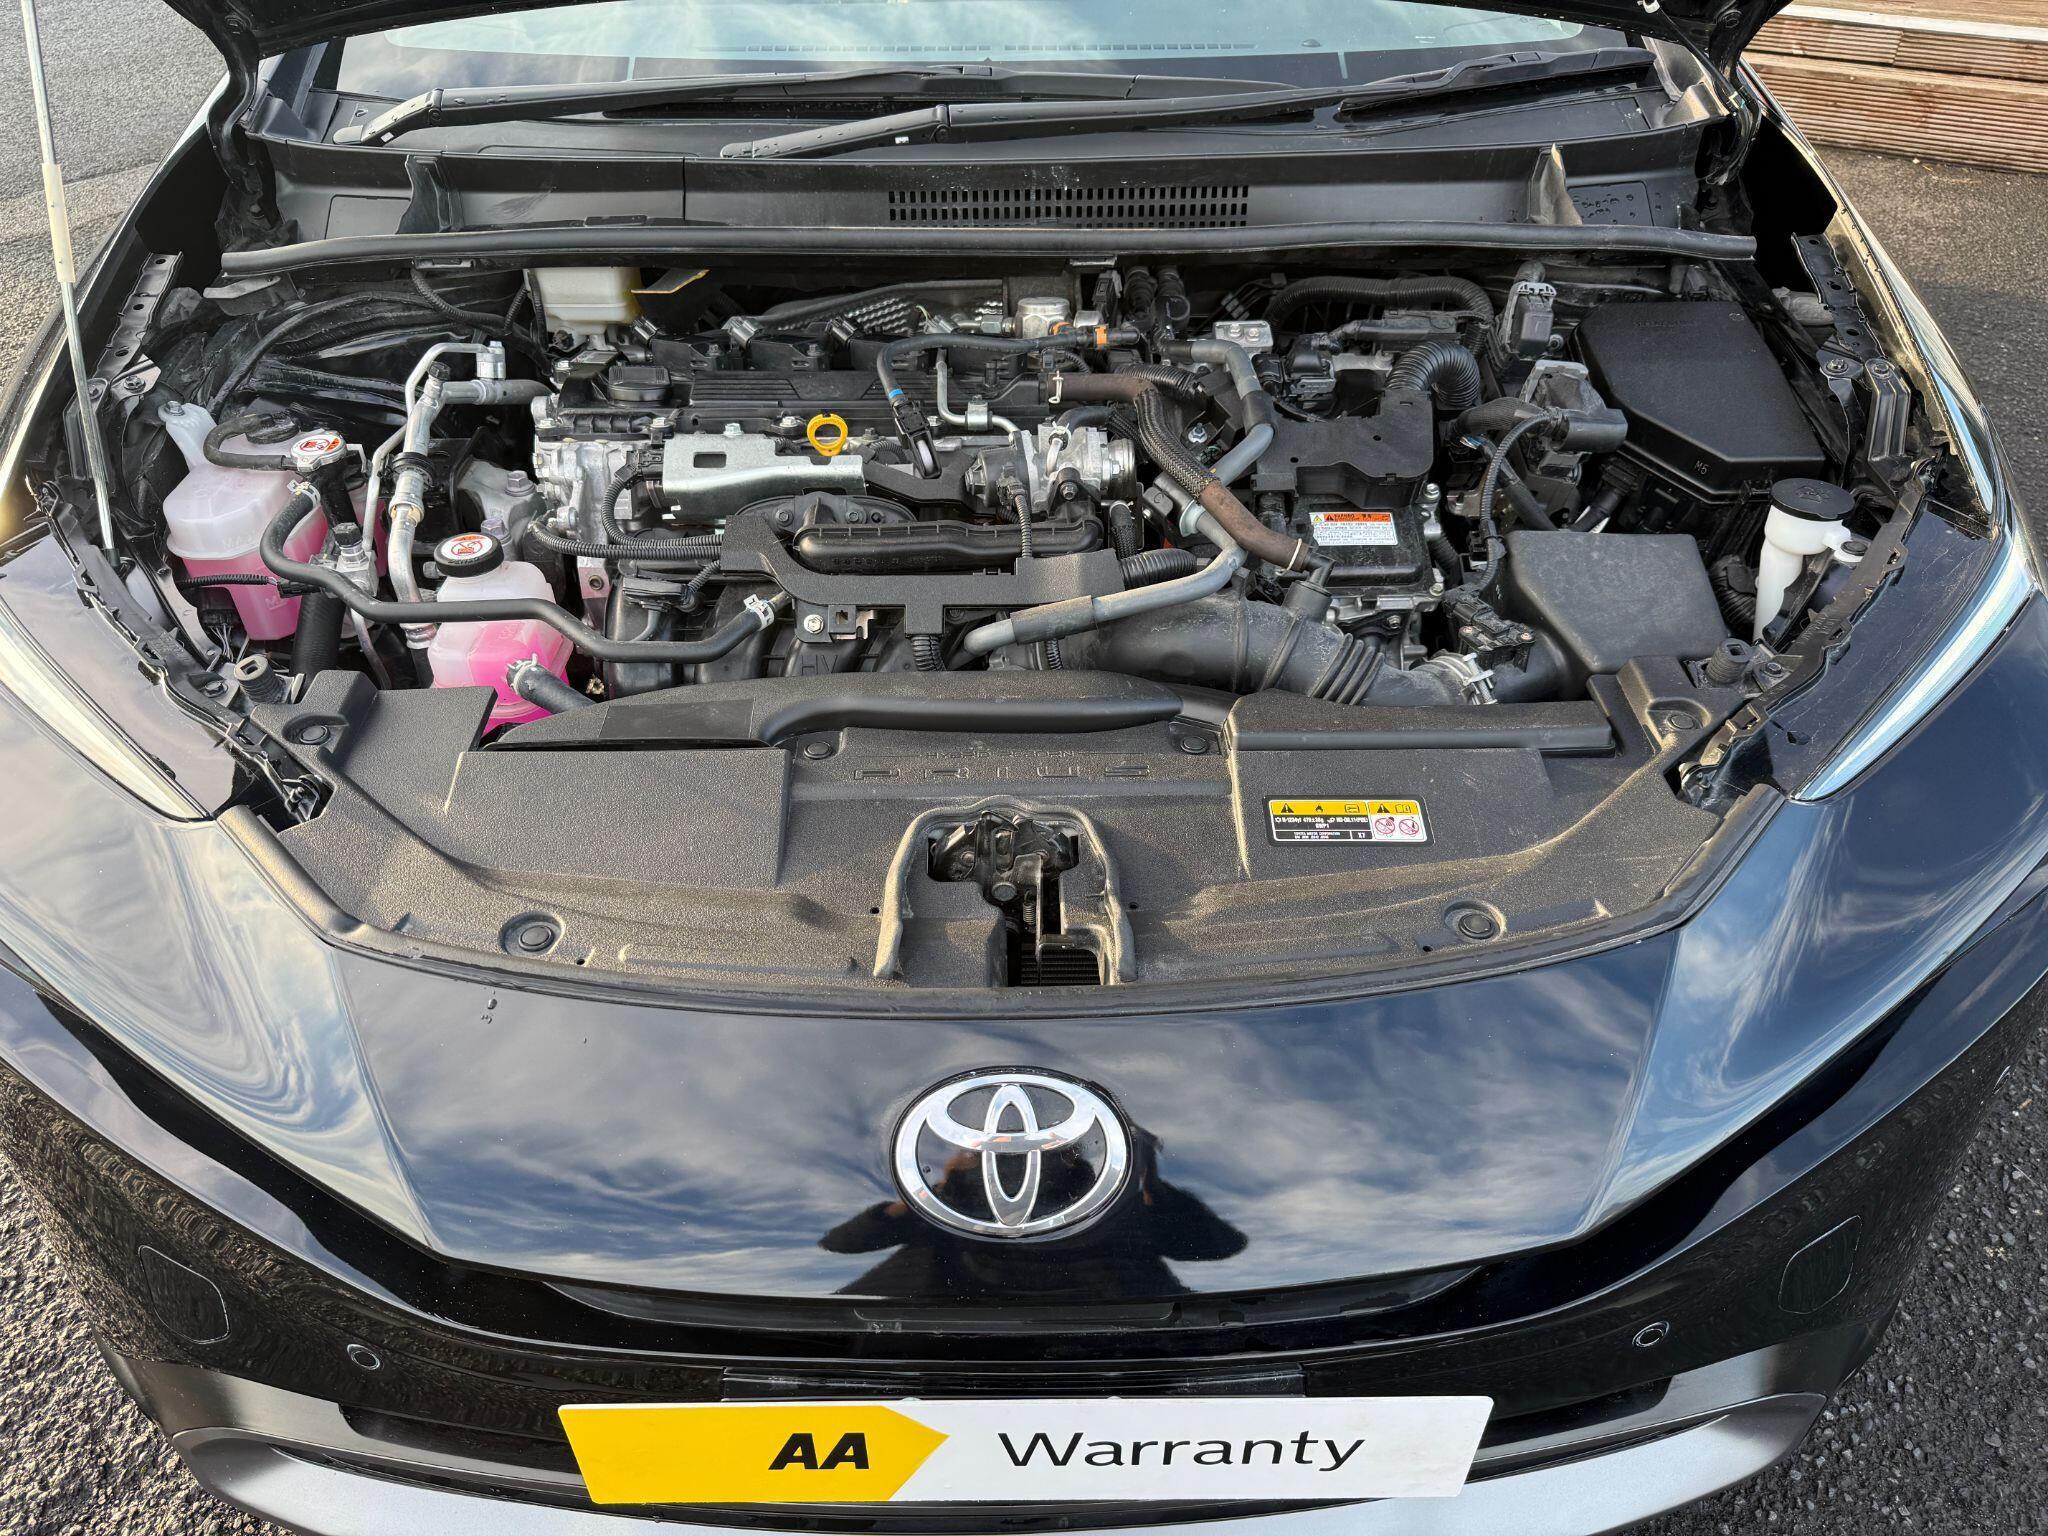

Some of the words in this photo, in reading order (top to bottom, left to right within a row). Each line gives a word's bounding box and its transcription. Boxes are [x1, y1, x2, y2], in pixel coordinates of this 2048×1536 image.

[801, 654, 838, 675] HV
[854, 764, 1150, 780] PRIUS
[768, 1432, 870, 1470] AA
[997, 1430, 1366, 1472] Warranty
